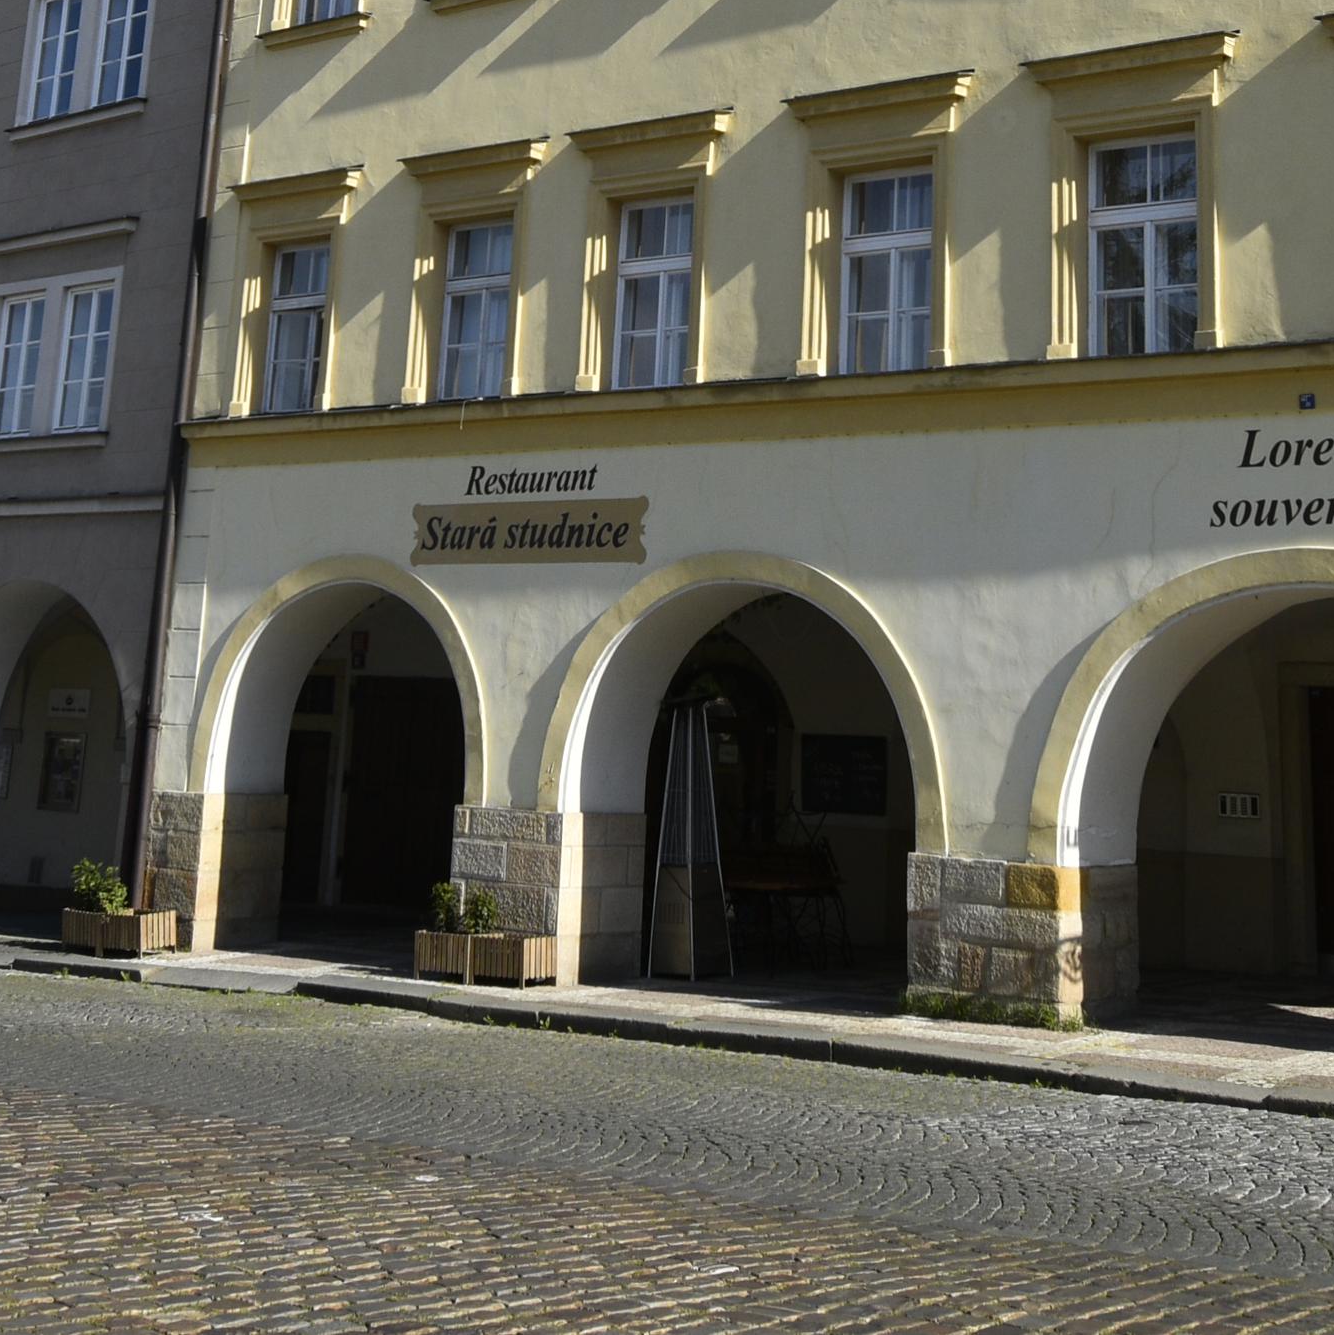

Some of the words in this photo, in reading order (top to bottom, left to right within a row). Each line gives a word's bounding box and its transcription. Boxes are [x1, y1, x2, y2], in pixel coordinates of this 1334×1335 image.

[464, 463, 598, 496] Restaurant
[421, 516, 496, 551] Stará
[503, 512, 629, 549] studnice
